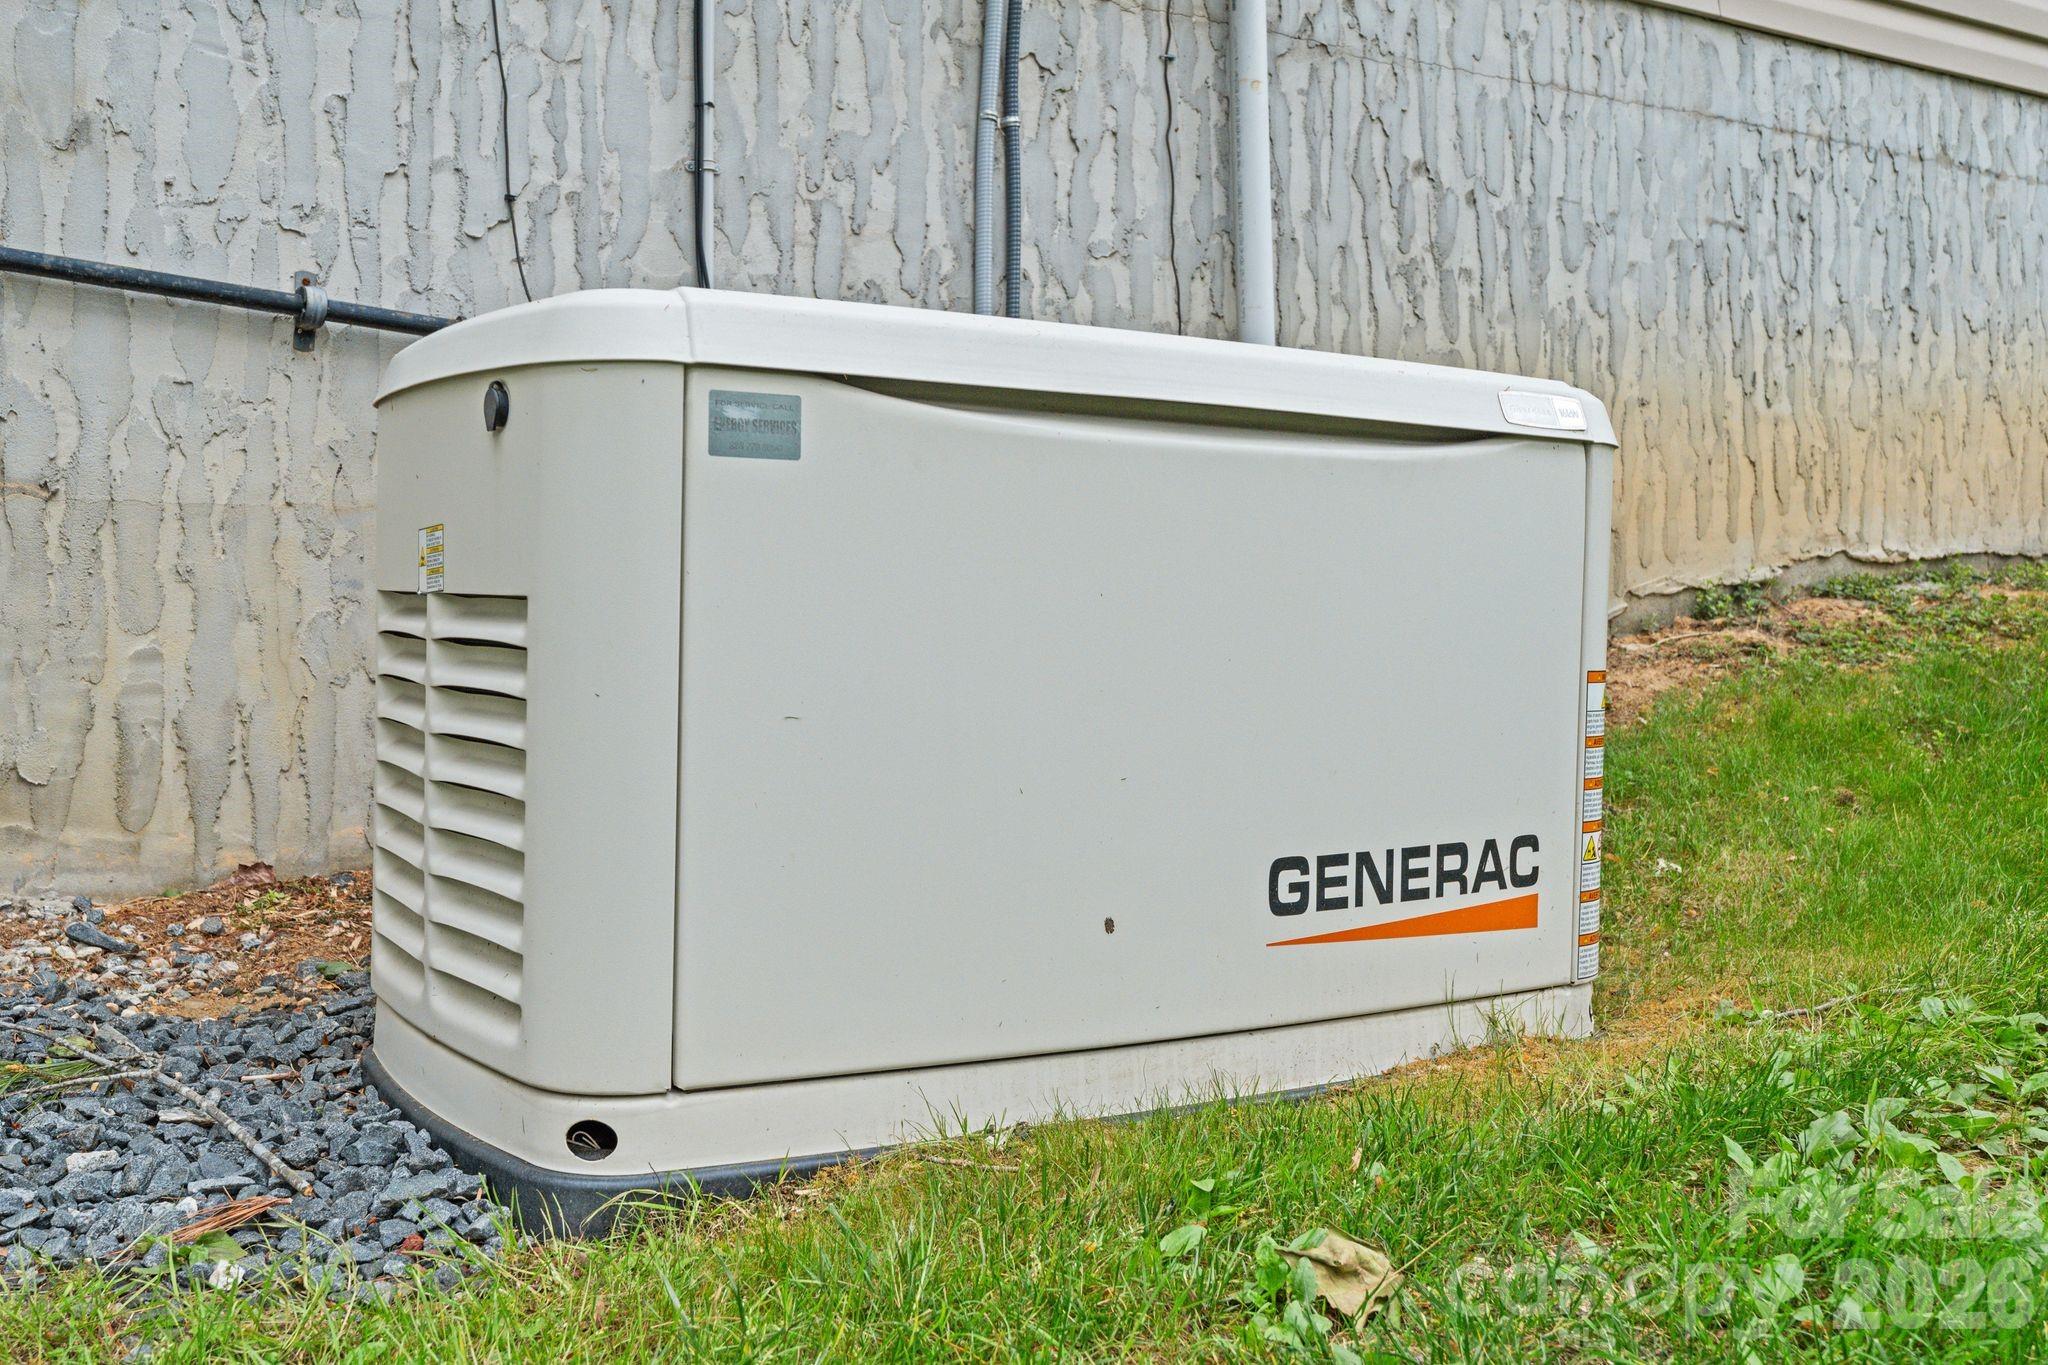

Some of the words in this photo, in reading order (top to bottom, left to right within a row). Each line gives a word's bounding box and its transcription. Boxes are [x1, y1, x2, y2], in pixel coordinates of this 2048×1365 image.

[772, 403, 794, 411] CALL
[752, 418, 798, 435] SERVICES
[1268, 834, 1539, 917] GENERAC
